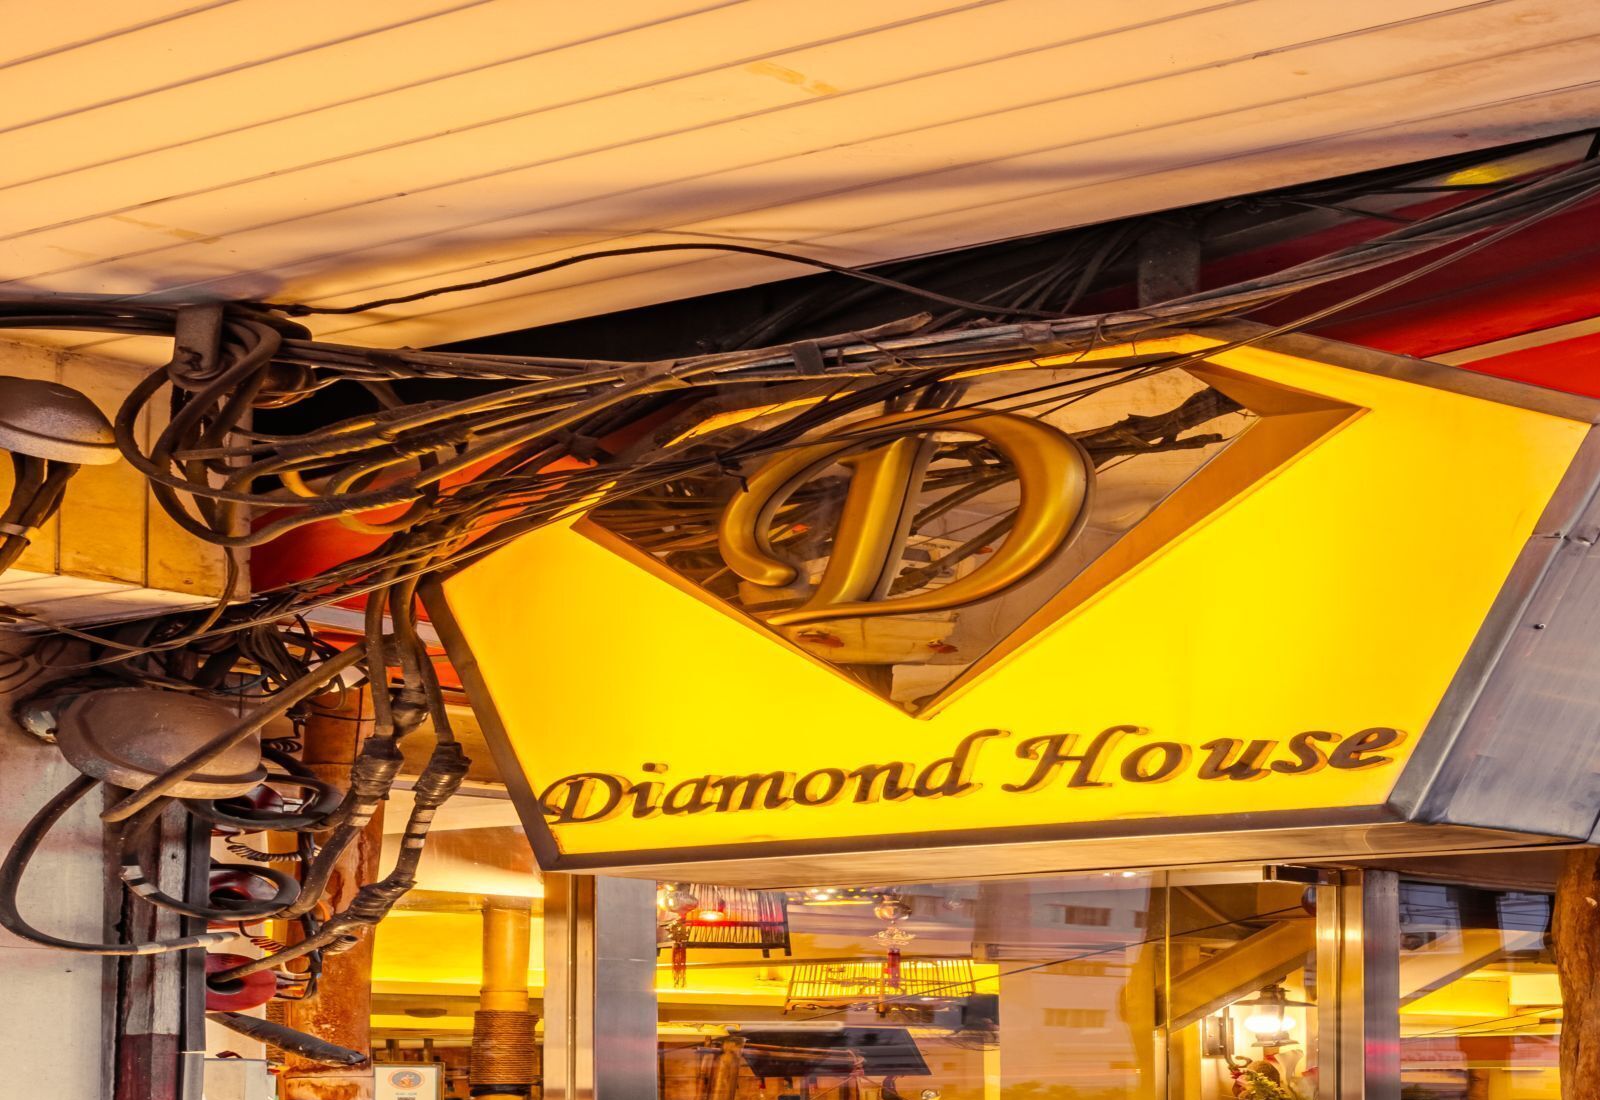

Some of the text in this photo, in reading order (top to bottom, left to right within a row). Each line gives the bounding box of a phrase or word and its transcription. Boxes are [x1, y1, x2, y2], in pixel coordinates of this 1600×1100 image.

[719, 408, 1096, 626] D
[538, 724, 1408, 825] Diamond House
